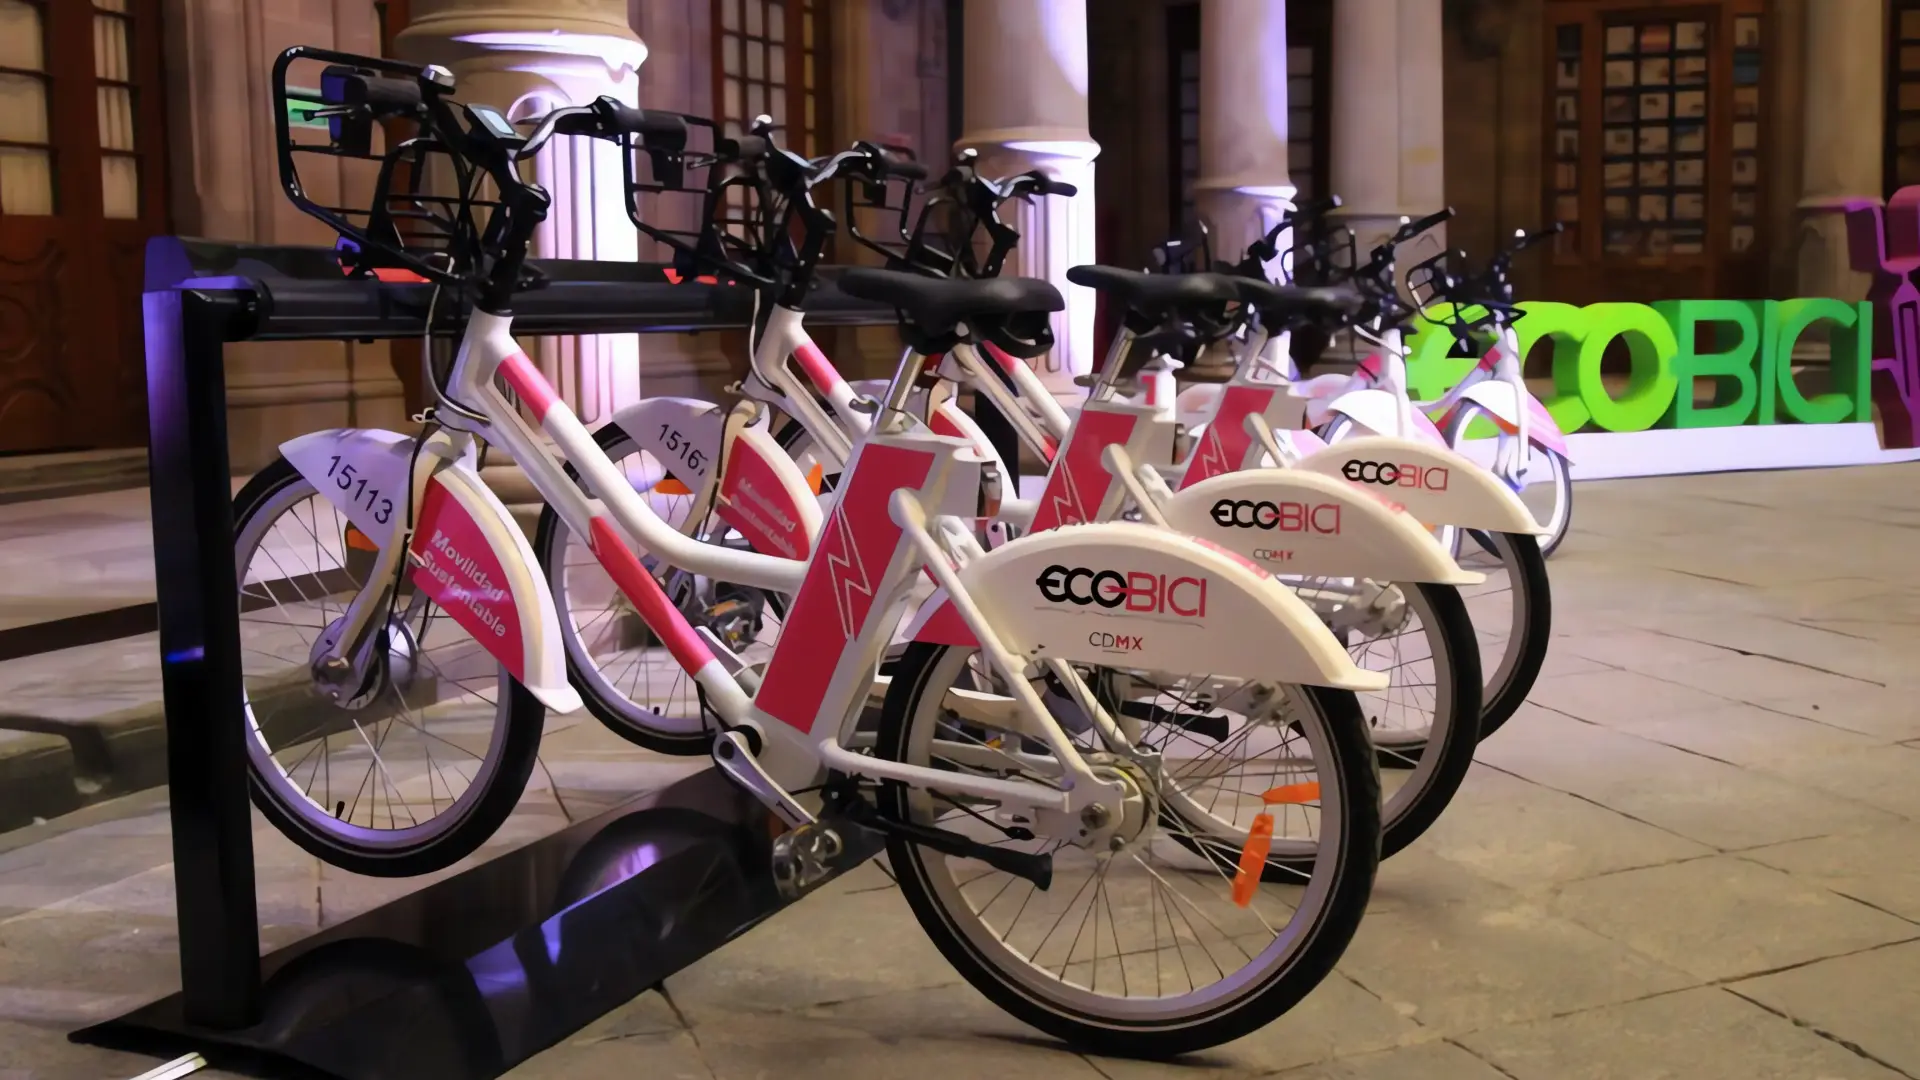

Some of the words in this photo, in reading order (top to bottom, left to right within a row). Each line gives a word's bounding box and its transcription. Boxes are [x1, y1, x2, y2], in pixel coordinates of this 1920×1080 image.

[327, 455, 393, 525] 15113
[1341, 459, 1448, 491] ECOBICI
[1210, 498, 1341, 535] ECOBICI
[431, 529, 505, 602] Movilidad
[1035, 564, 1207, 618] ECOBICI
[422, 550, 506, 636] Sustentable
[1088, 631, 1144, 651] CDMX
